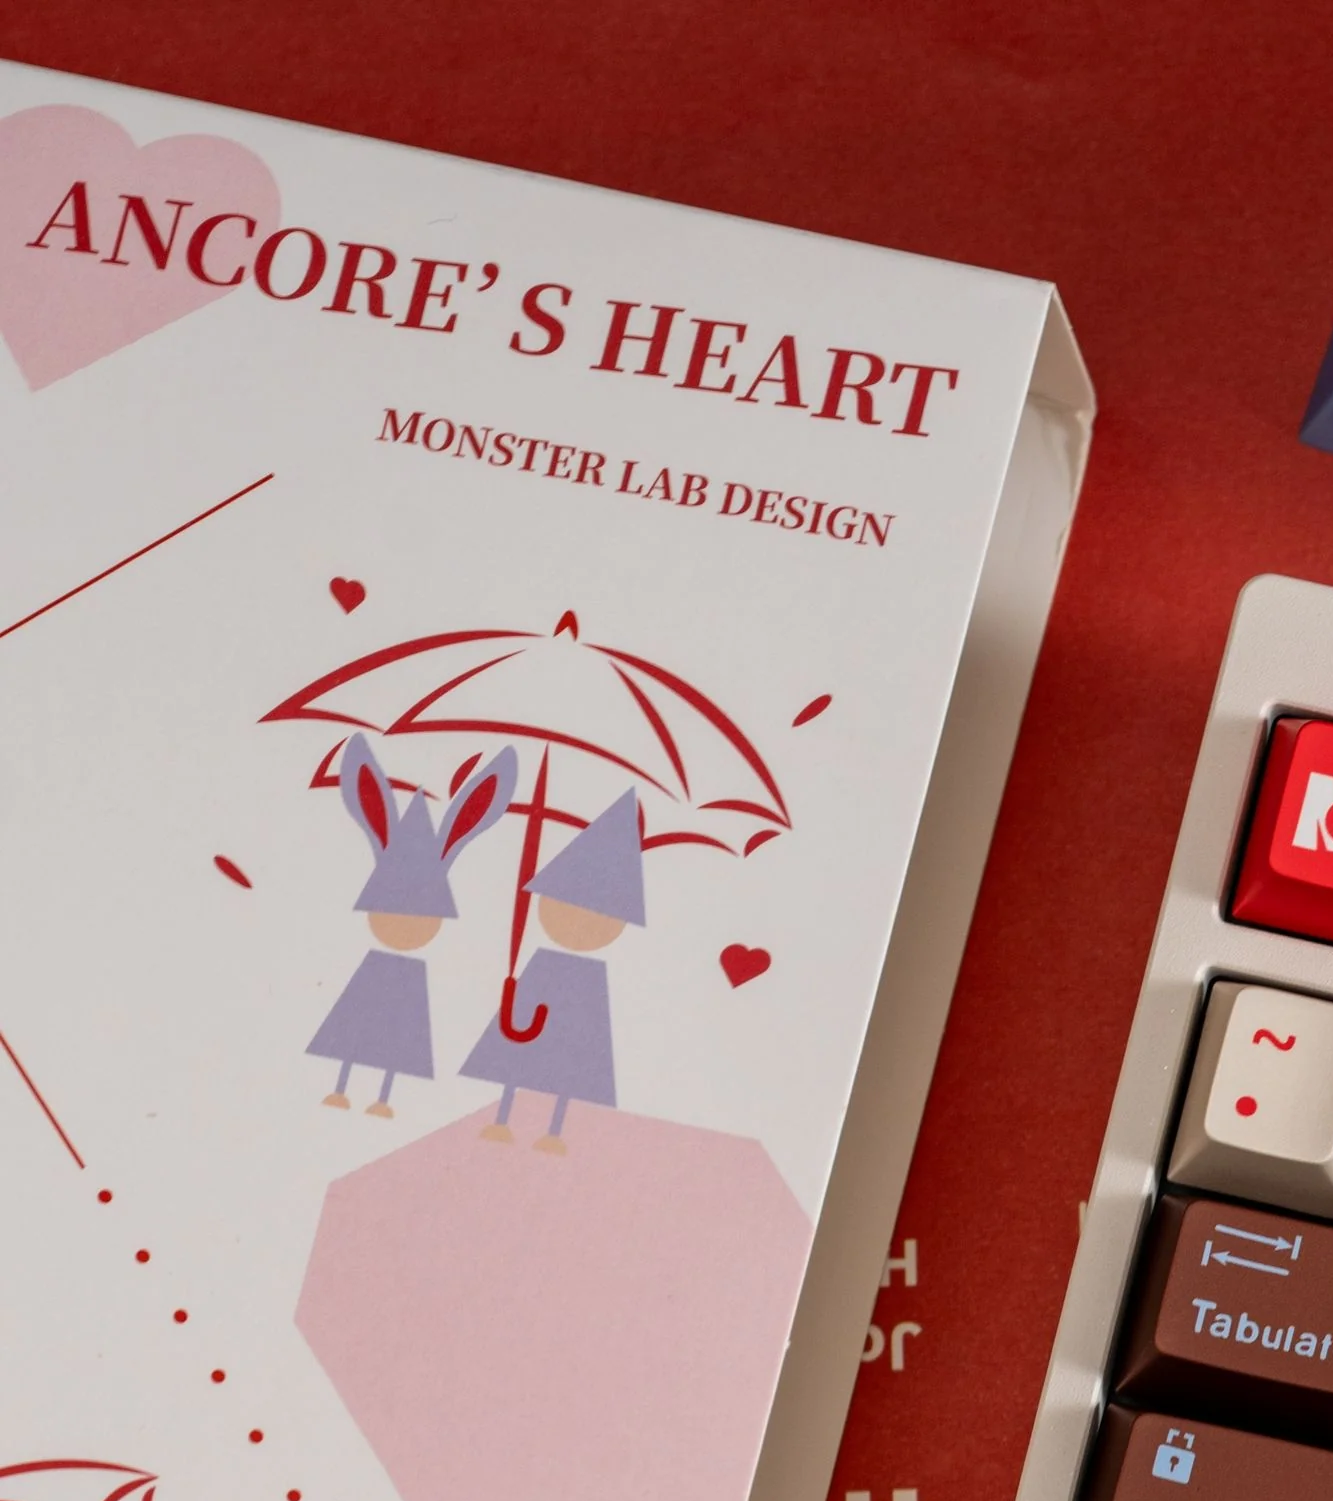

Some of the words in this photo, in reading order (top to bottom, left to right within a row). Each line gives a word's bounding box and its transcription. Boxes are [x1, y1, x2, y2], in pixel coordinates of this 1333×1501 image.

[592, 299, 958, 438] HEART
[378, 407, 607, 486] MONSTER
[617, 460, 709, 508] LAB
[719, 482, 894, 548] DESIGN
